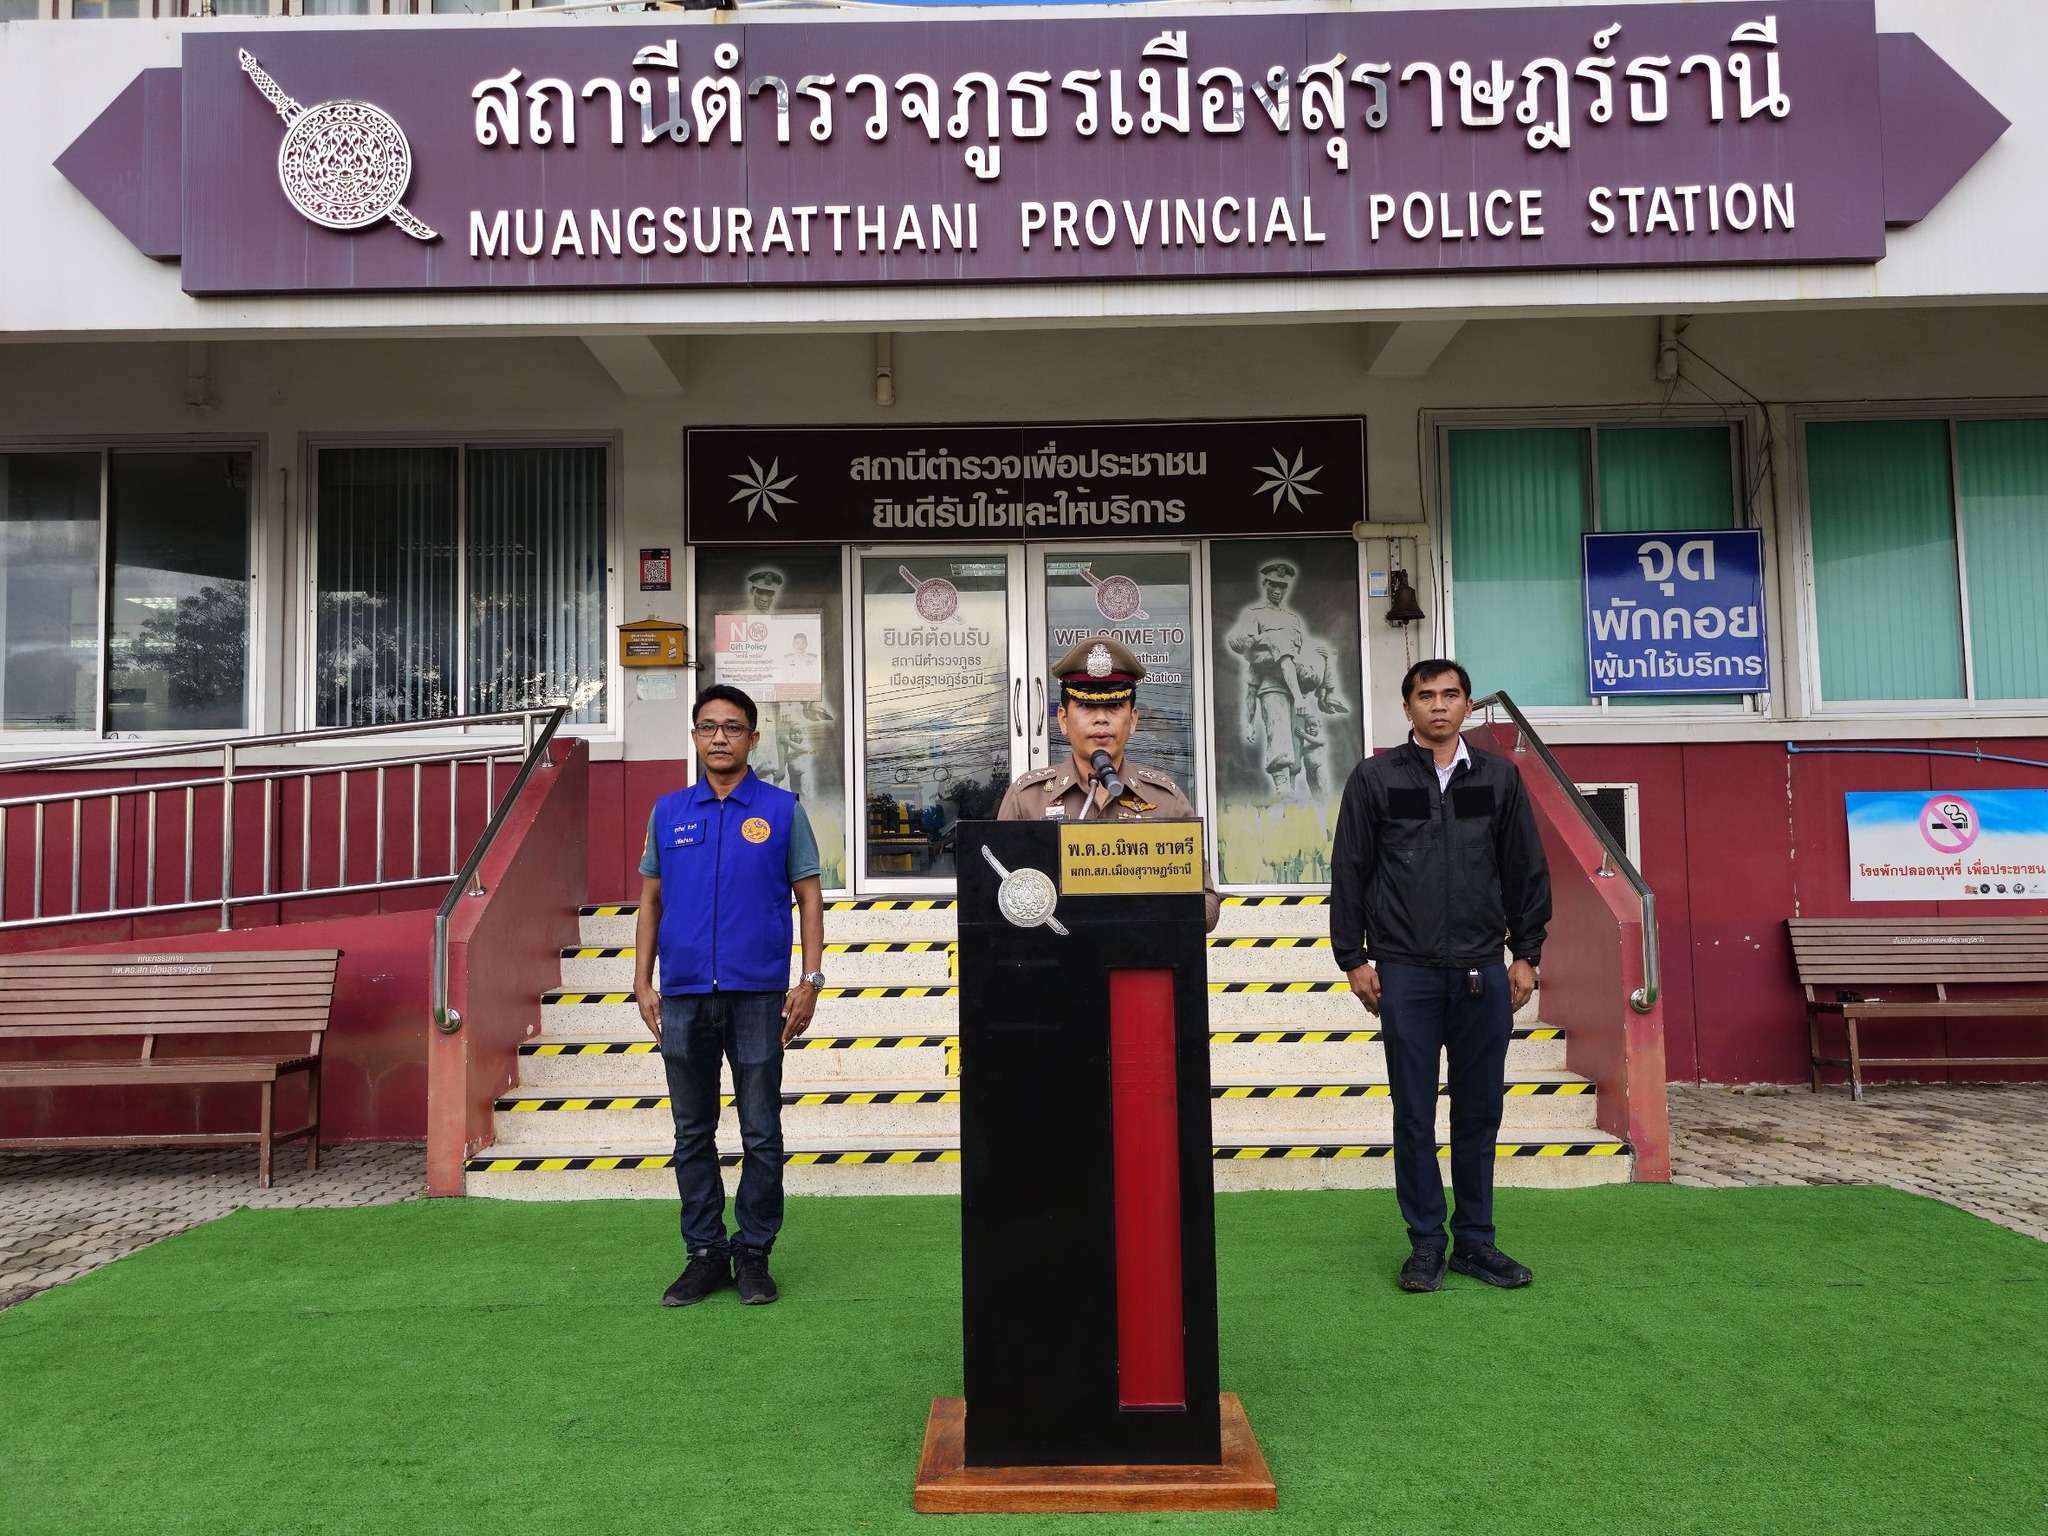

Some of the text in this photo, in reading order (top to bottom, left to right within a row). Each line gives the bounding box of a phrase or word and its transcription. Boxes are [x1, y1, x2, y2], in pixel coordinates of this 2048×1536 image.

[471, 15, 1791, 180] สถานีตำรวจภูธรเมืองสุราษฎร์ธานี
[469, 182, 1796, 258] MUANGSURATTHANI PROVINCIAL POLICE STATION
[849, 441, 1208, 482] สถานีตำรวจเพื่อประชาชน
[872, 486, 1186, 529] ยินดีรับใช้และให้บริการ
[1636, 540, 1717, 597] จุด
[1591, 597, 1758, 641] พักคอย
[883, 626, 990, 647] ยินดีต้อนรับ
[1159, 628, 1185, 645] TO
[730, 643, 768, 652] Gift Policy
[891, 653, 982, 670] สถานีตำรวจภูธร
[1593, 648, 1763, 686] ผู้มาใช้บริการ
[890, 672, 985, 688] เมืองสุราษฎร์ธานี
[1145, 671, 1180, 683] Station
[1068, 837, 1194, 857] พ.ต.อ.นิพล ชาตรี
[1071, 862, 1192, 880] ผกก.สภ.เมืองสุราษฎร์ธานี
[1859, 858, 2047, 881] โรงพักปลอดบุหรี่ เพื่อประชาชน
[137, 954, 184, 963] คณะกรรมการ
